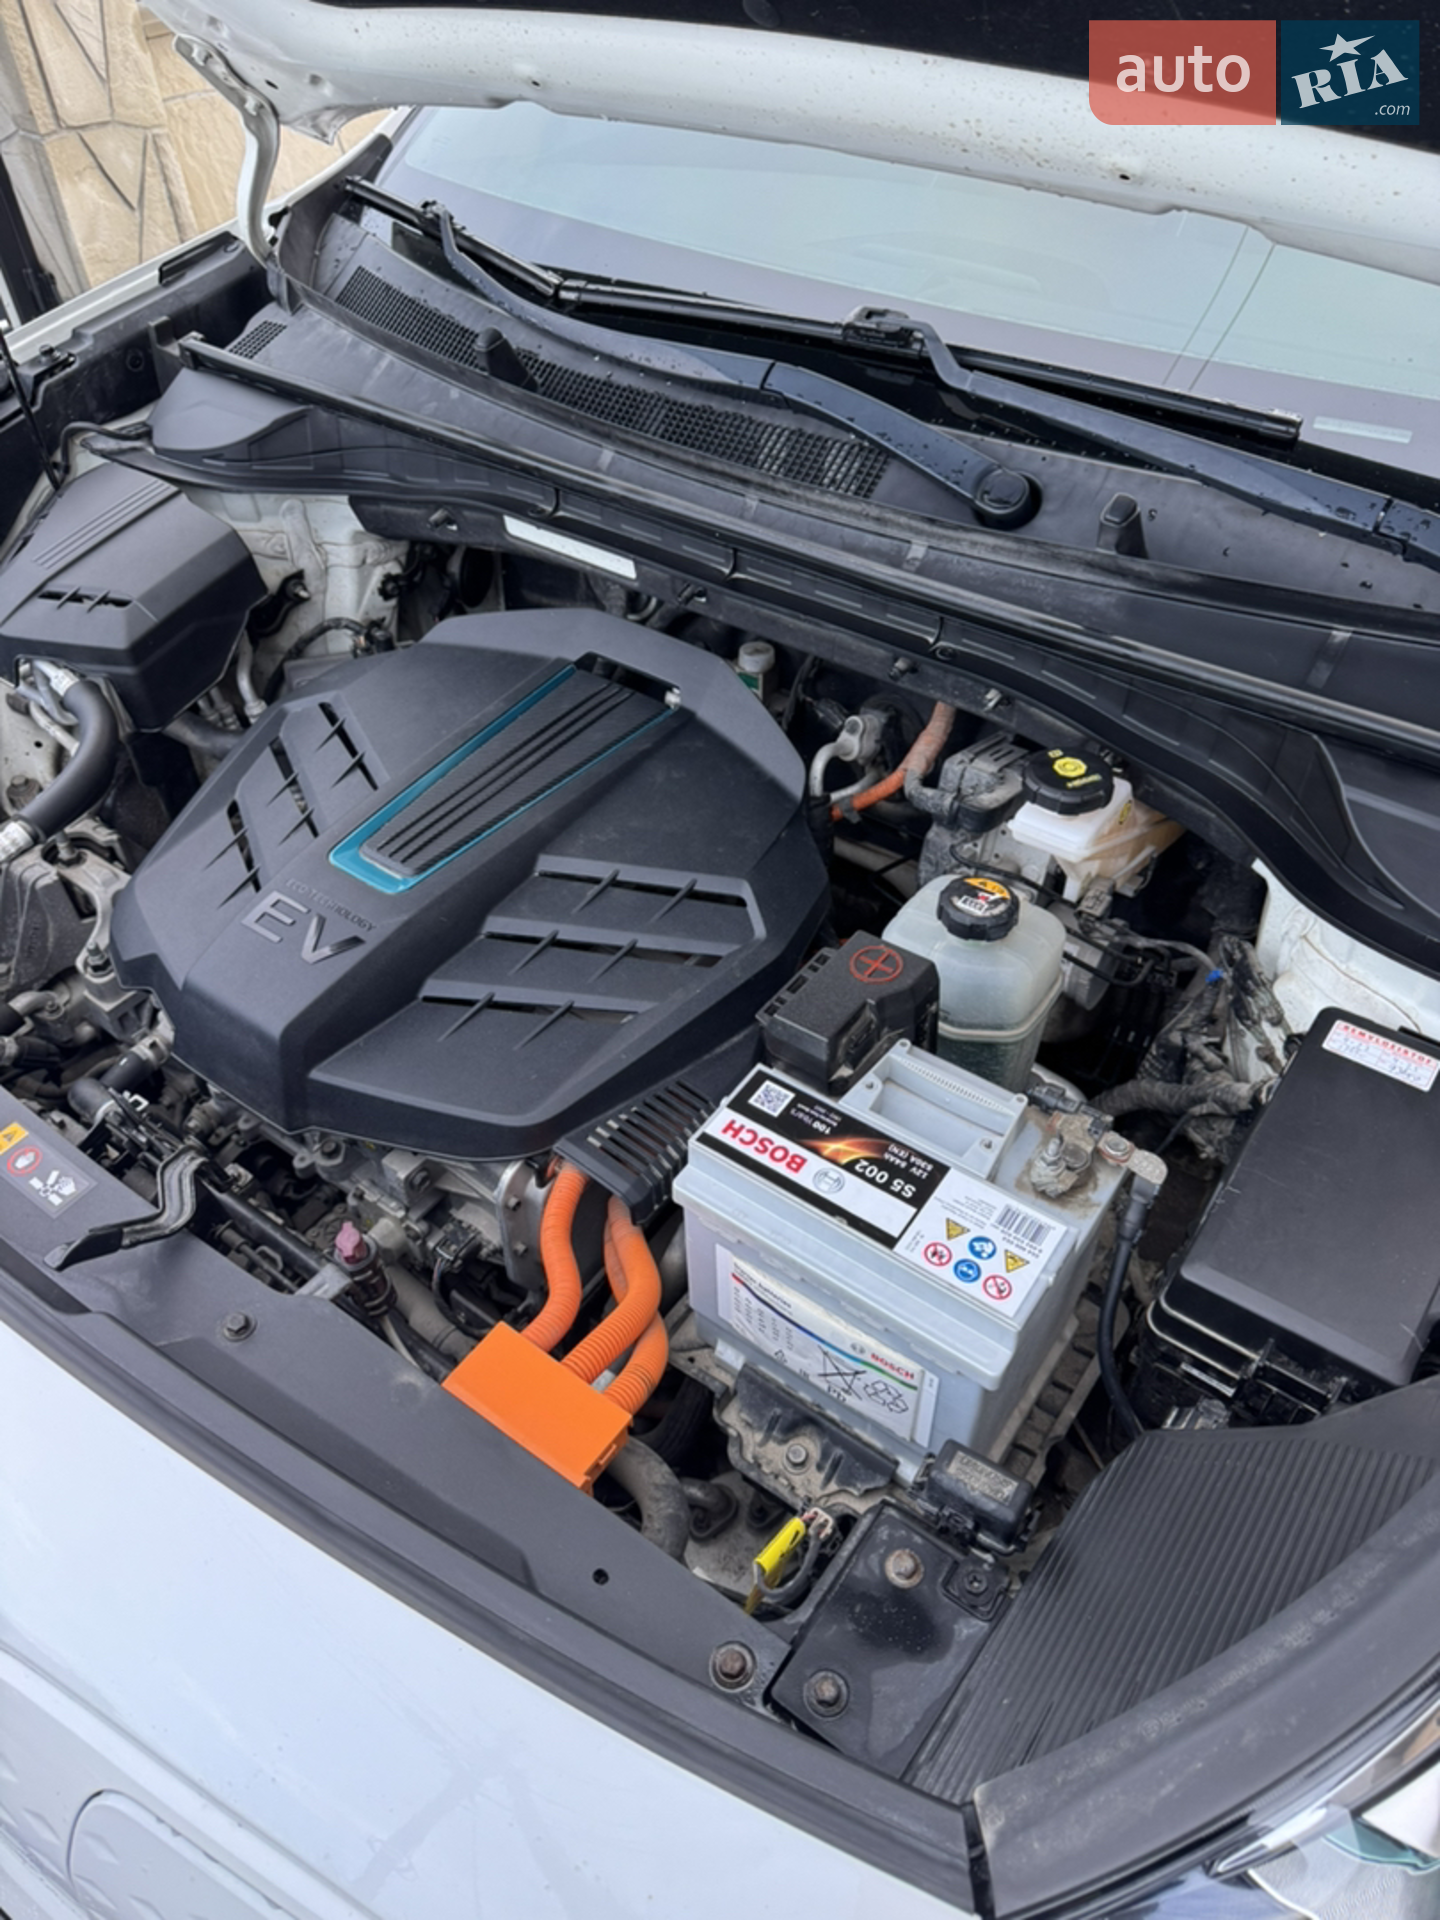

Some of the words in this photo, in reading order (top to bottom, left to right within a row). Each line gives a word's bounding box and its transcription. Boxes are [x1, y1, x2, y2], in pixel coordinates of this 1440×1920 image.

[286, 878, 308, 895] ECO
[309, 887, 376, 932] TECHNOLOGY
[241, 890, 367, 965] EV
[811, 1119, 832, 1135] 100
[721, 1118, 808, 1174] BOSCH
[854, 1158, 889, 1184] 002
[908, 1166, 929, 1180] 12V
[889, 1178, 917, 1199] S5
[870, 1352, 916, 1381] BOSCH
